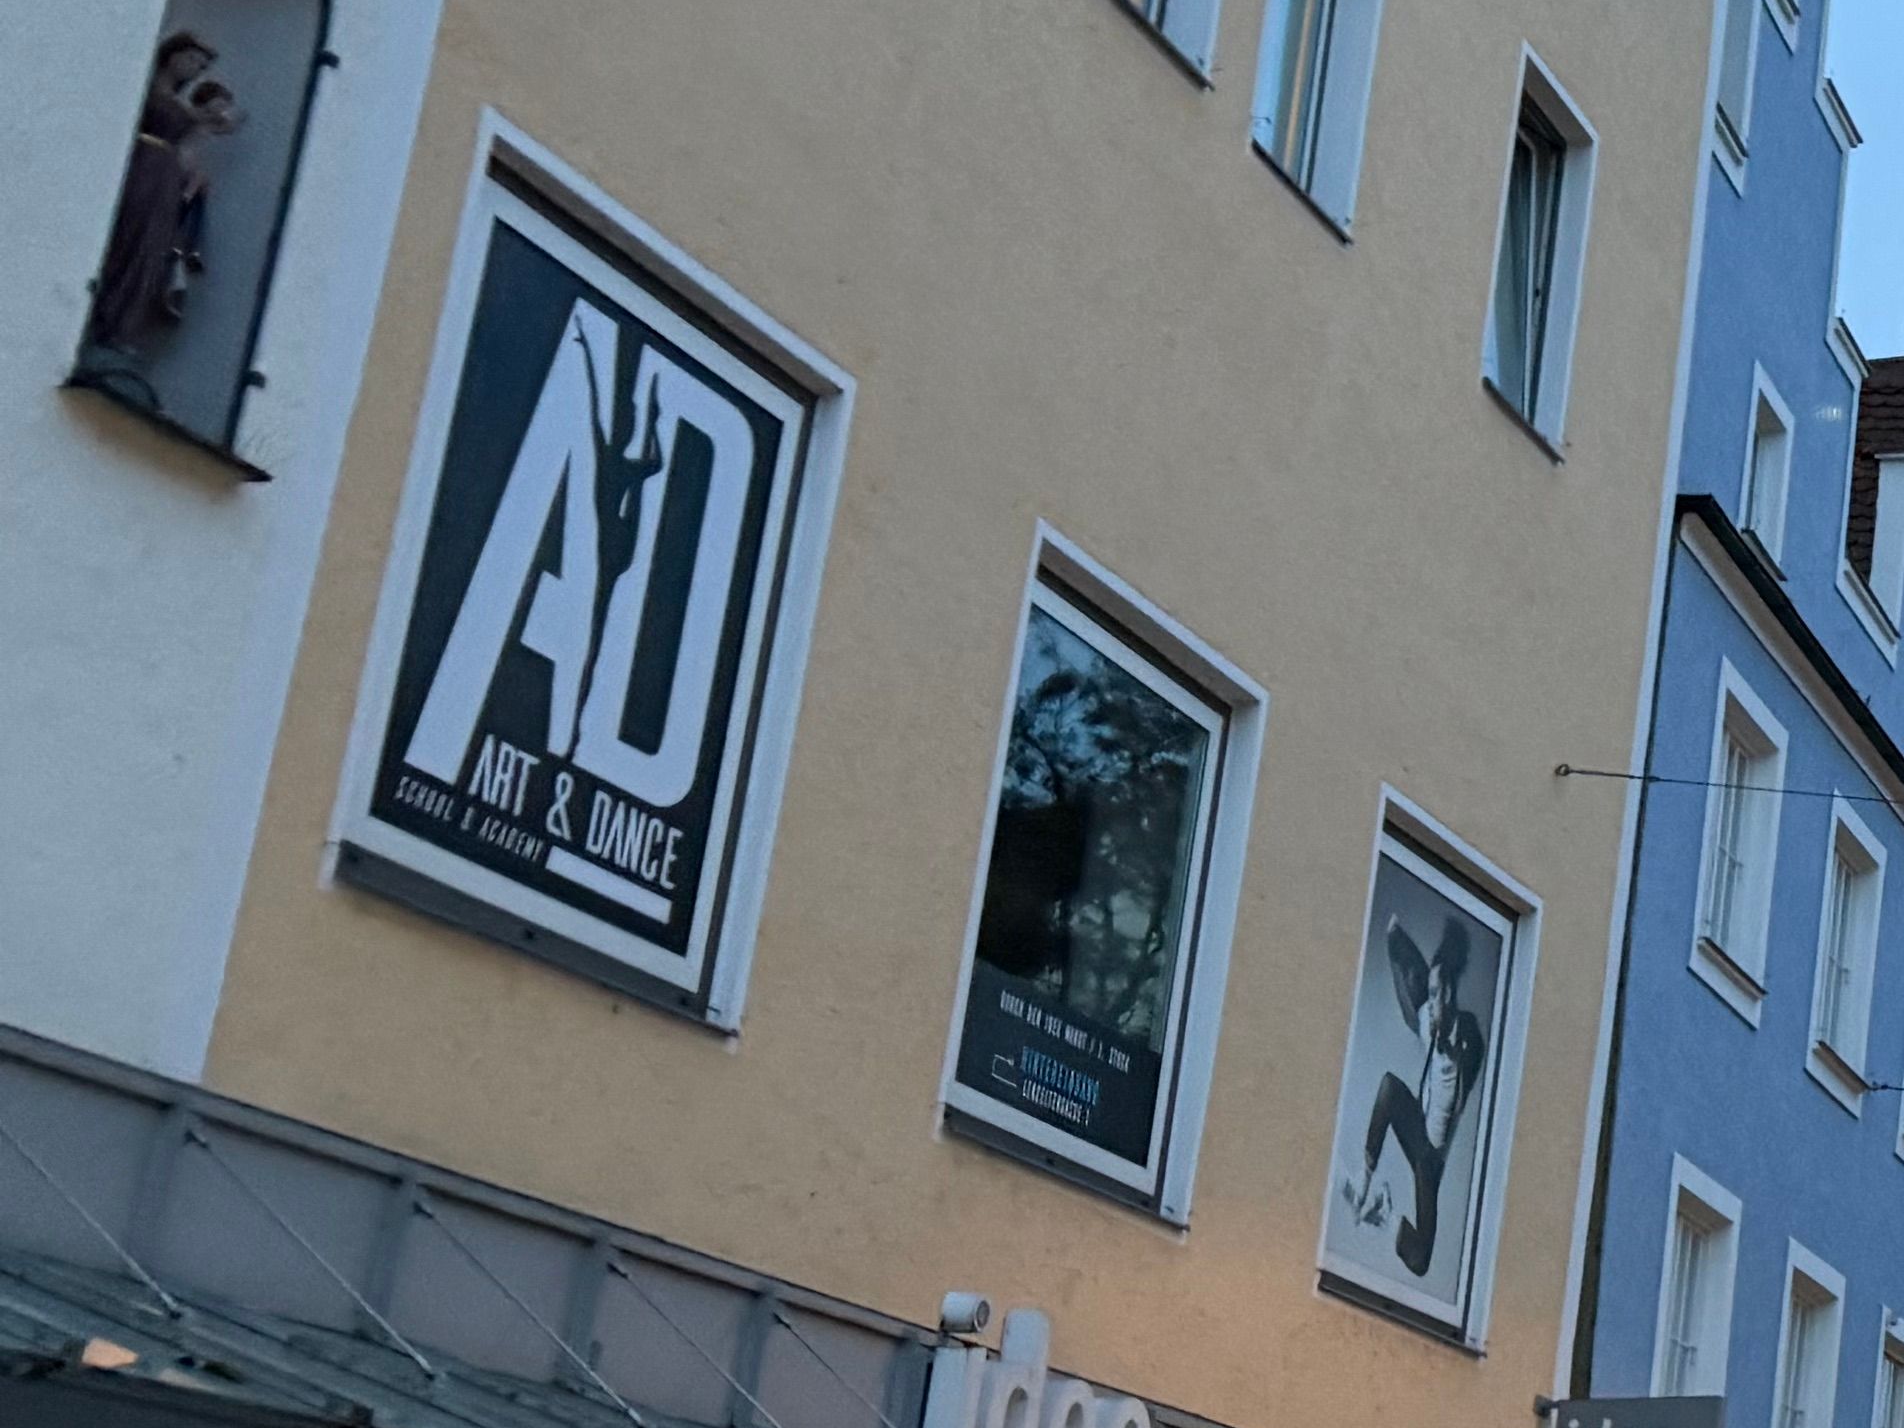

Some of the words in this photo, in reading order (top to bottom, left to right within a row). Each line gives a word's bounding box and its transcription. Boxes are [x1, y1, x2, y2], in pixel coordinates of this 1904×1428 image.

[394, 776, 454, 821] SCHOOL
[478, 815, 545, 862] ACADEMY
[468, 734, 540, 817] ART
[546, 772, 574, 842] &
[585, 790, 684, 890] DANCE
